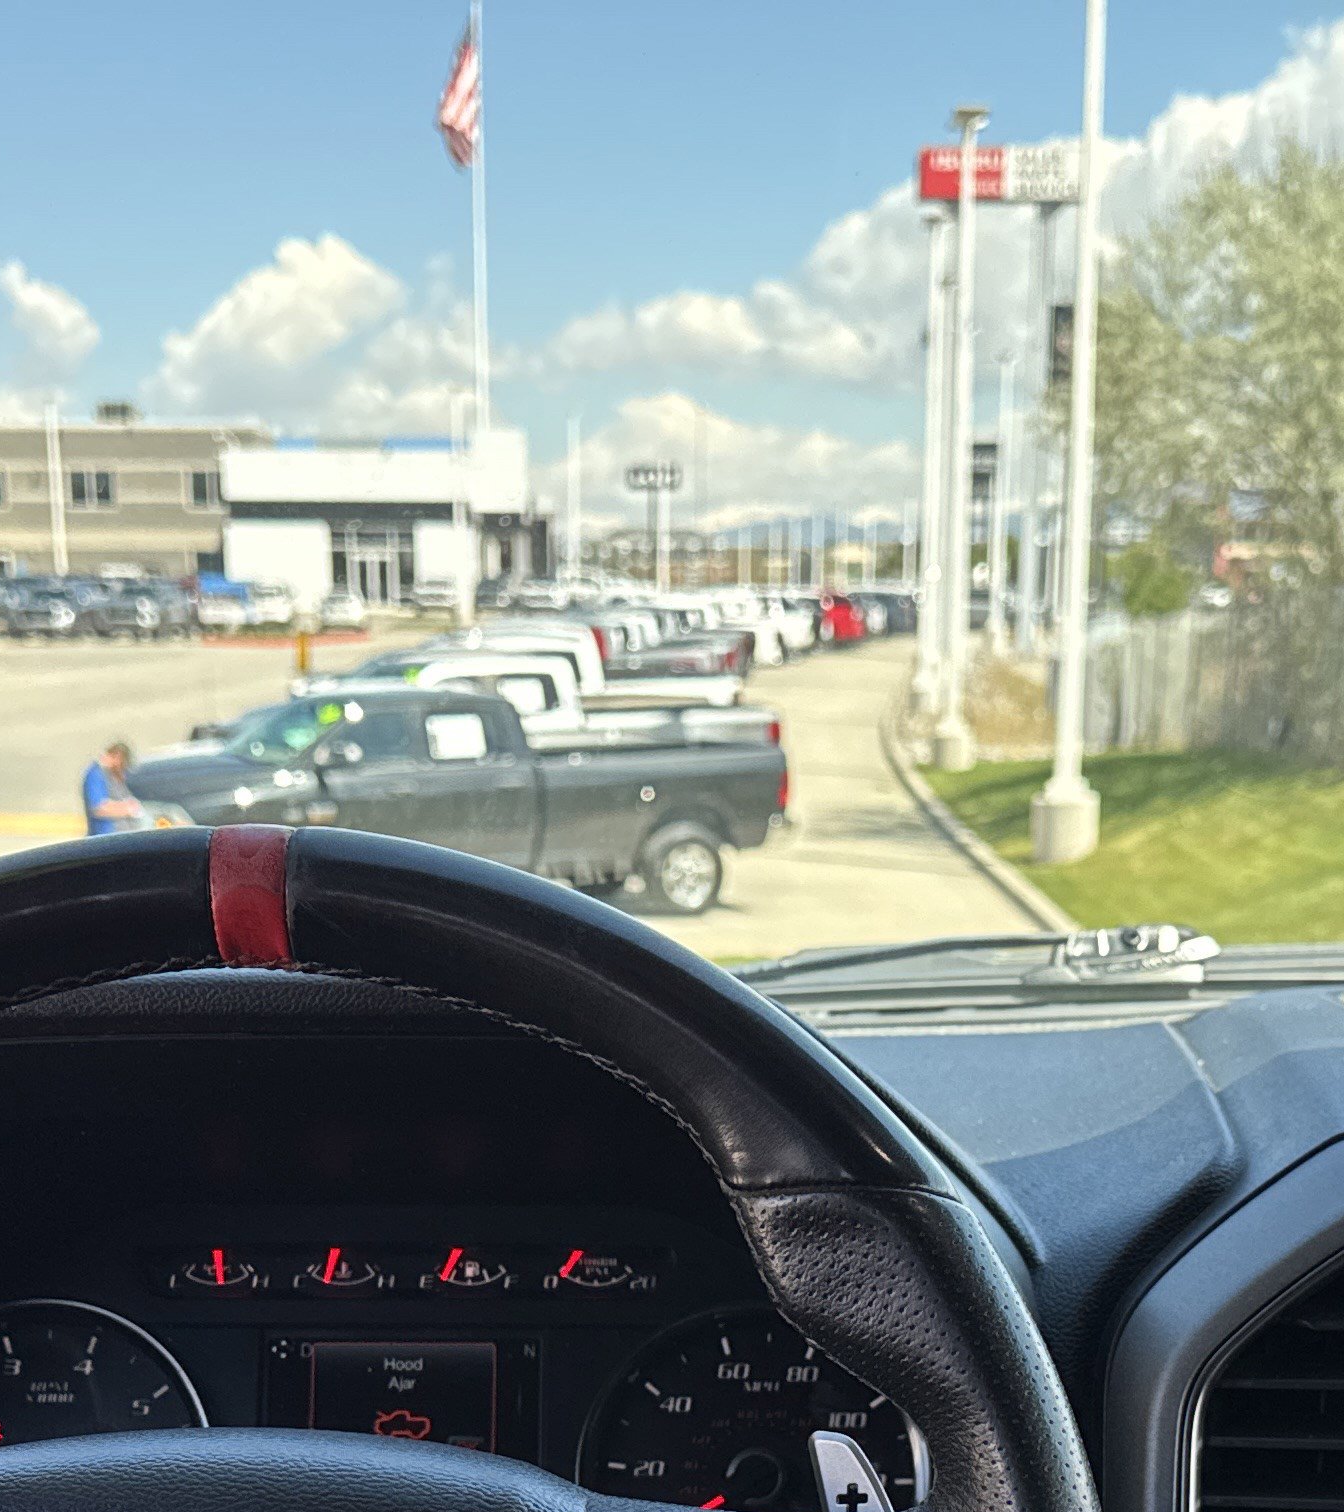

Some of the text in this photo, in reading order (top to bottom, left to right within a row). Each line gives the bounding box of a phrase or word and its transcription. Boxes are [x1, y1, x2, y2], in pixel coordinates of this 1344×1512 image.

[377, 1274, 396, 1289] H
[419, 1274, 435, 1289] E
[503, 1274, 519, 1289] F
[3, 1358, 22, 1376] 3
[73, 1358, 94, 1376] 4
[383, 1357, 424, 1372] Hood
[717, 1363, 752, 1380] 60
[786, 1366, 820, 1383] 80
[388, 1376, 416, 1391] Ajar
[131, 1399, 150, 1416] 5
[659, 1396, 693, 1413] 40
[828, 1412, 868, 1429] 100
[633, 1460, 666, 1477] 20
